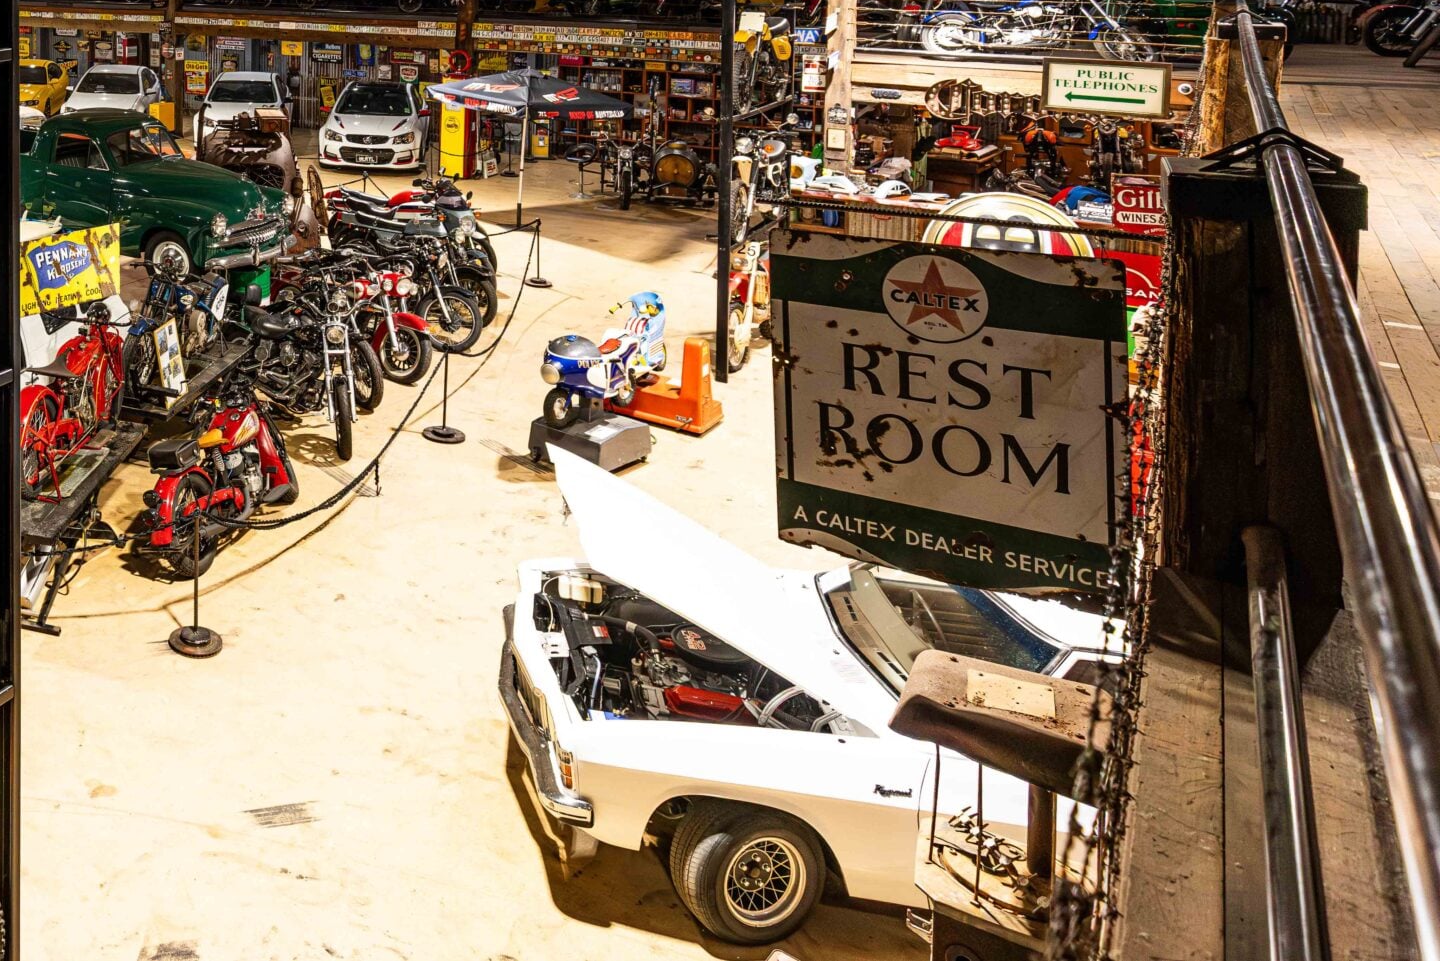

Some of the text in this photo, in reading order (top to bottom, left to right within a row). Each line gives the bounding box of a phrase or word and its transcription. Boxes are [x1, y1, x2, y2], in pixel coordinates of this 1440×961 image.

[312, 52, 343, 61] CIGARETTES
[1076, 68, 1135, 81] PUBLIC
[1053, 77, 1158, 94] TELEPHONES
[1121, 213, 1156, 224] WINES
[35, 247, 88, 268] PENNANT
[56, 290, 79, 303] HEATIN
[890, 288, 981, 313] CALTEX
[1125, 287, 1160, 299] SAN
[841, 342, 1052, 420] REST
[817, 401, 1071, 495] ROOM
[794, 505, 1110, 590] A CALTEX DEALER SERVICE
